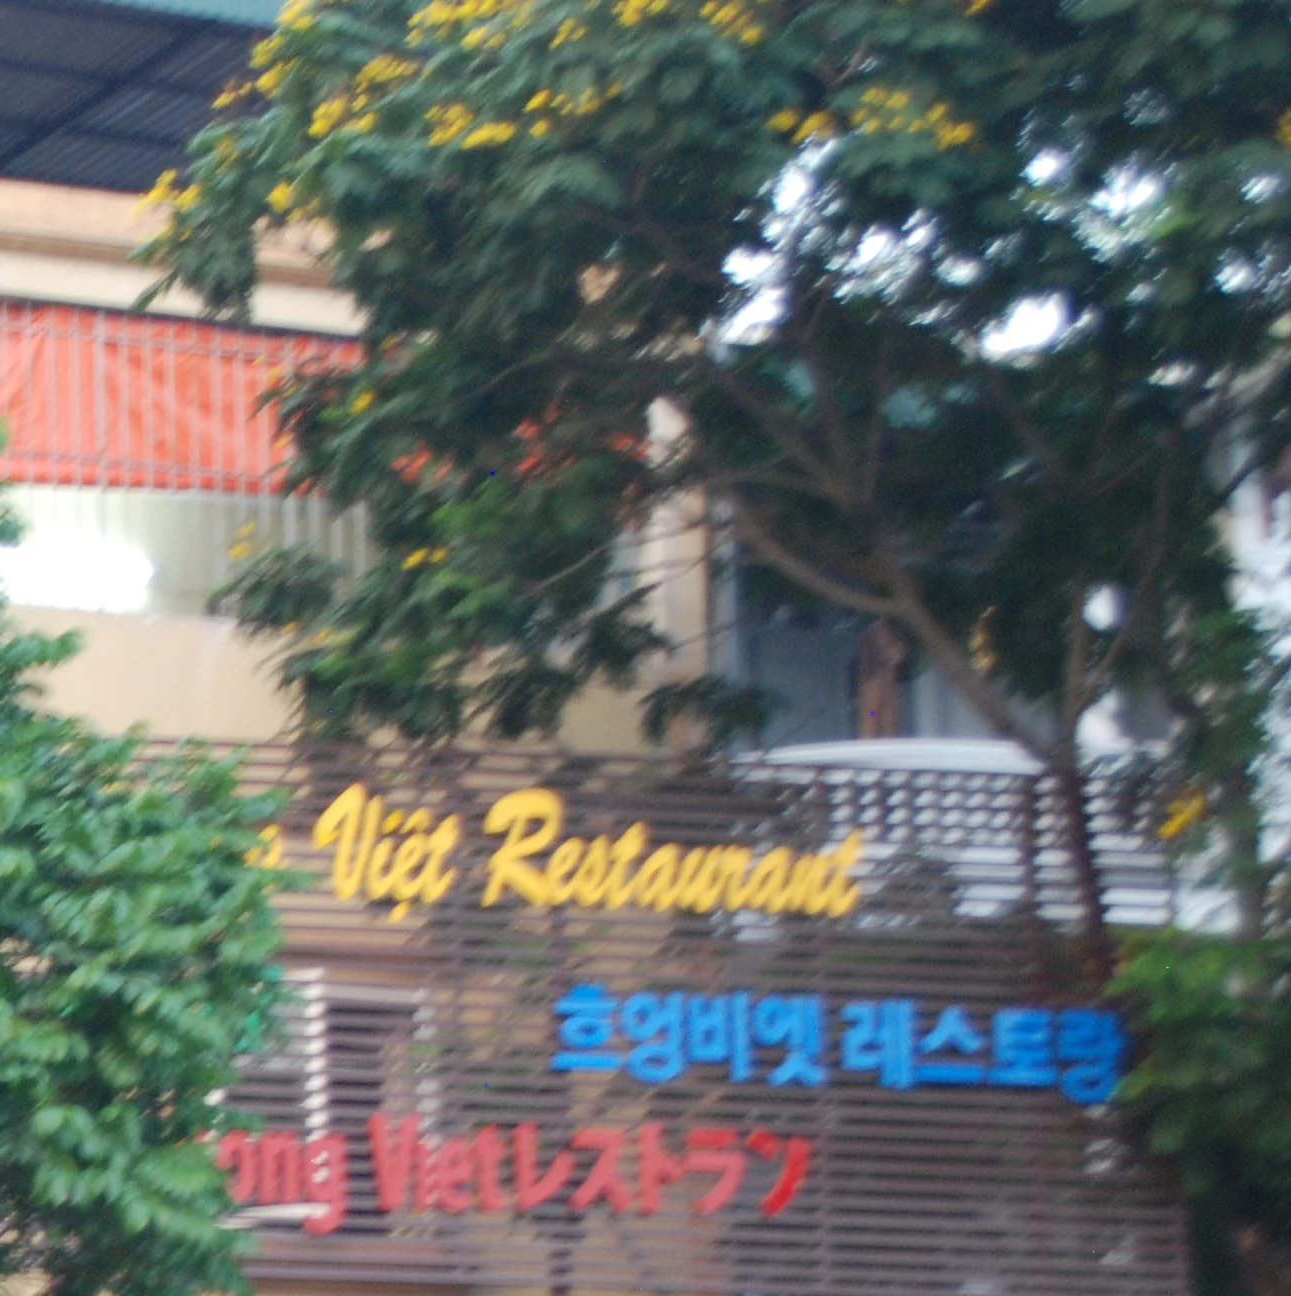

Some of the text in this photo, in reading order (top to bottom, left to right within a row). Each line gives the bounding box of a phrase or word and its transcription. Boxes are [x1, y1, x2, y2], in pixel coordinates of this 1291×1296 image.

[312, 782, 462, 923] Việt
[481, 787, 864, 918] Restaurant
[839, 996, 1125, 1106] 레스토랑
